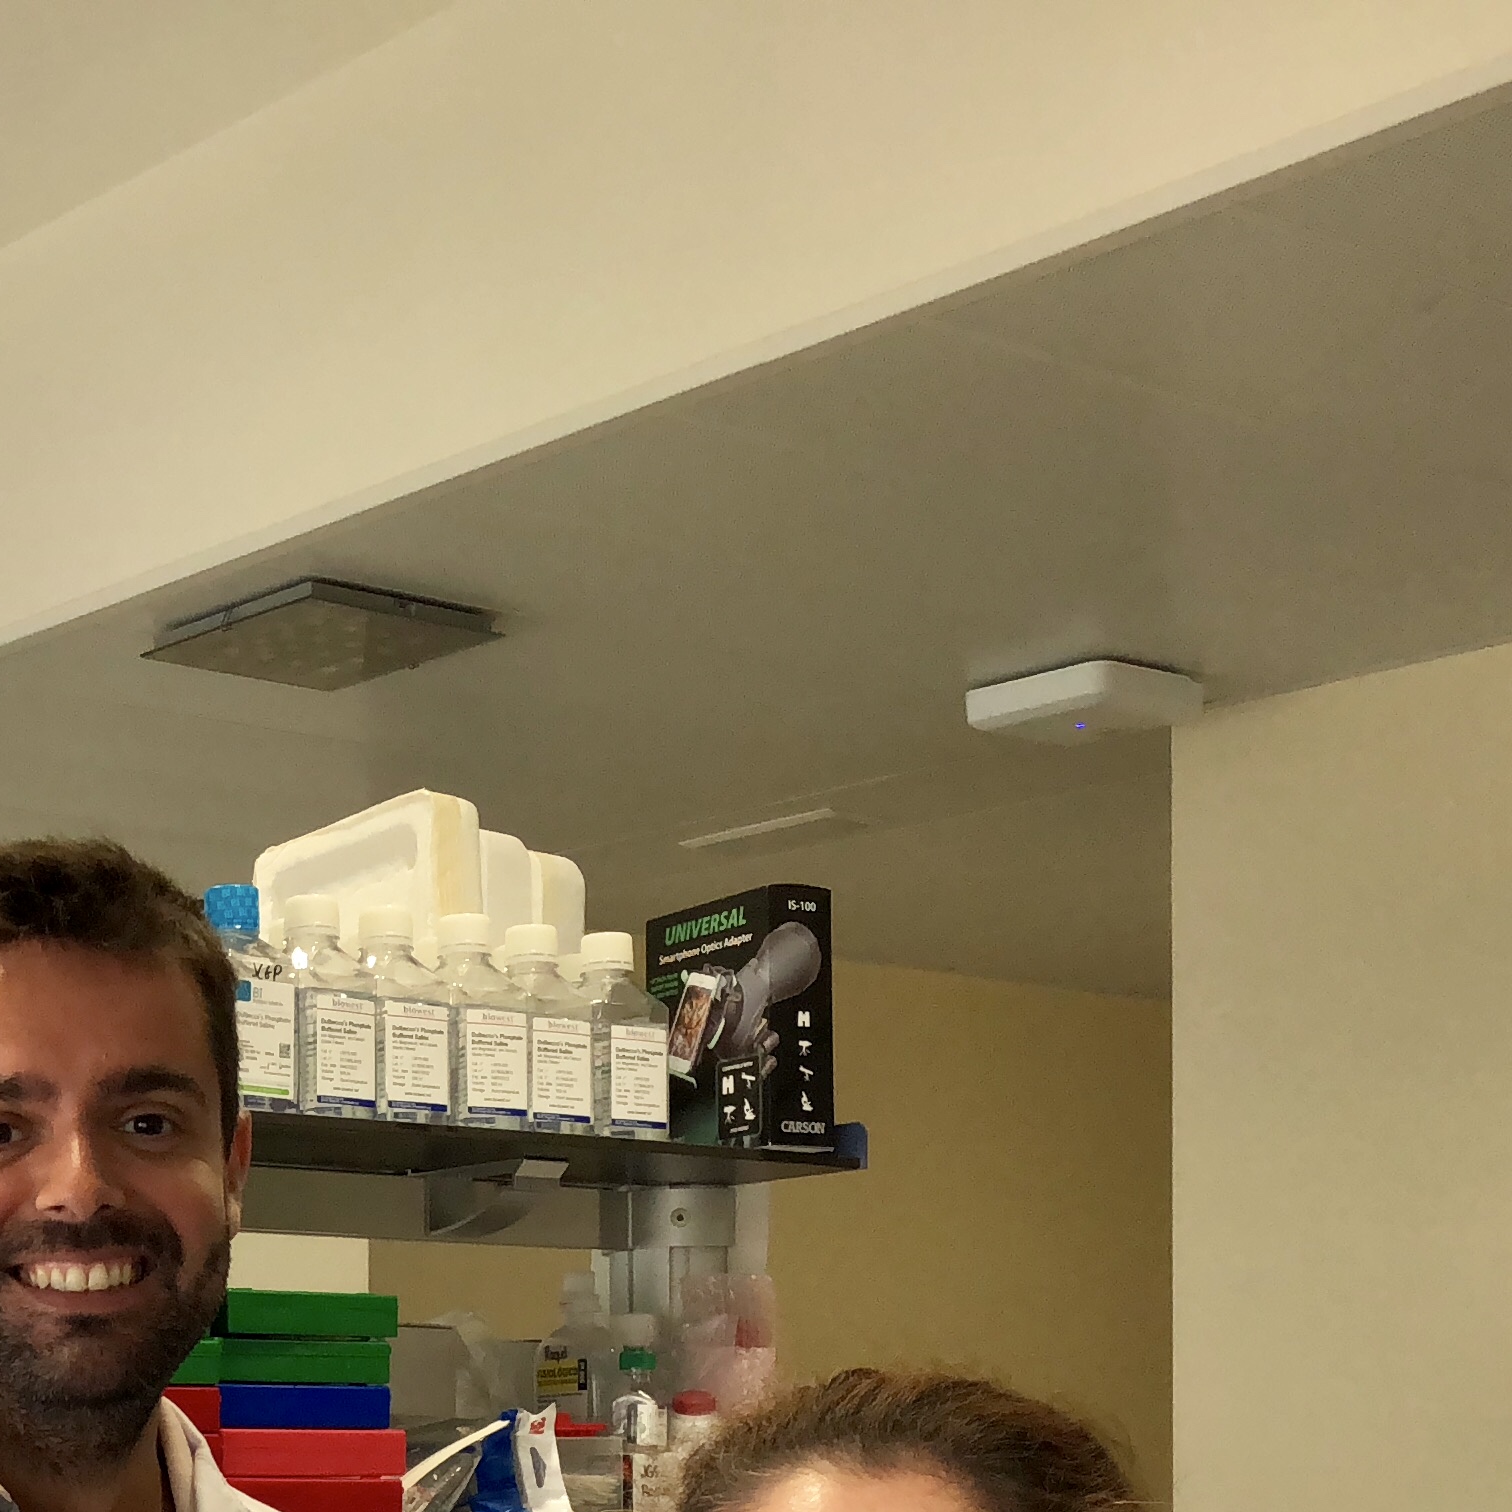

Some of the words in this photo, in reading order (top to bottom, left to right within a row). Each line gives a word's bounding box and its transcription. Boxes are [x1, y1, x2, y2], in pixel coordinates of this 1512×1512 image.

[788, 900, 818, 912] IS-100
[665, 906, 747, 946] UNIVERSAL
[658, 946, 700, 966] Smartphone
[700, 940, 723, 955] Optics
[724, 932, 754, 947] Adapter
[781, 1121, 826, 1134] CARSON
